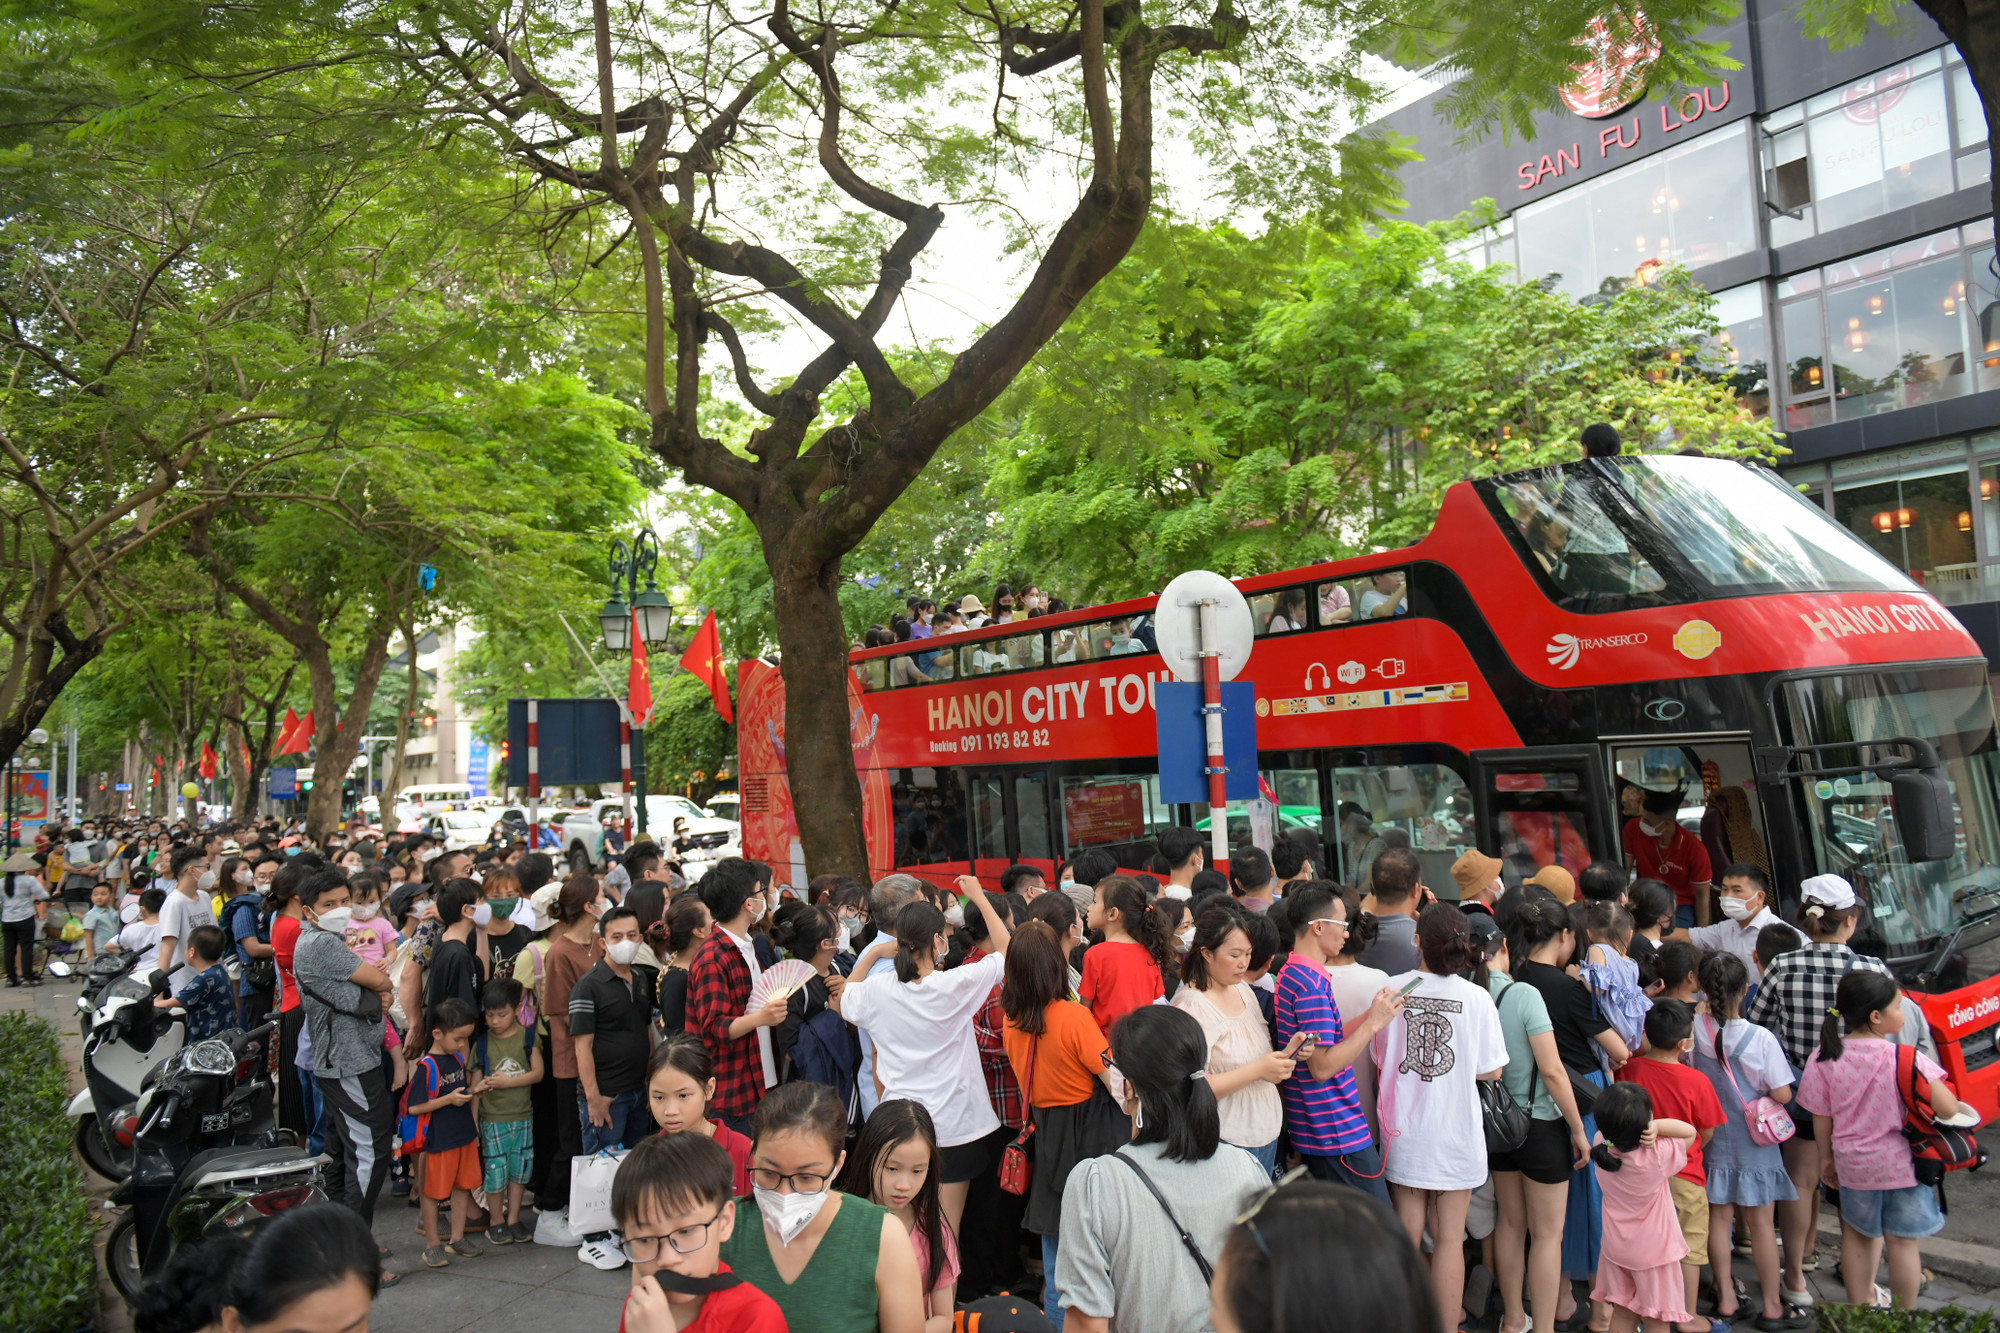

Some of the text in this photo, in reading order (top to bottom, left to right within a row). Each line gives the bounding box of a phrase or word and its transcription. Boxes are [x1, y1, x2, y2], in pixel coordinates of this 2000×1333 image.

[1518, 80, 1730, 190] SAN FU LOU
[1800, 605, 1899, 642] HANOI
[1889, 604, 1940, 632] CITY
[1579, 633, 1648, 650] TRANSERCO
[928, 670, 1182, 731] HANOI CITY TOU
[930, 728, 1050, 753] Booking 091 193 82 82
[1948, 996, 1999, 1028] TỔNG CÔNG
